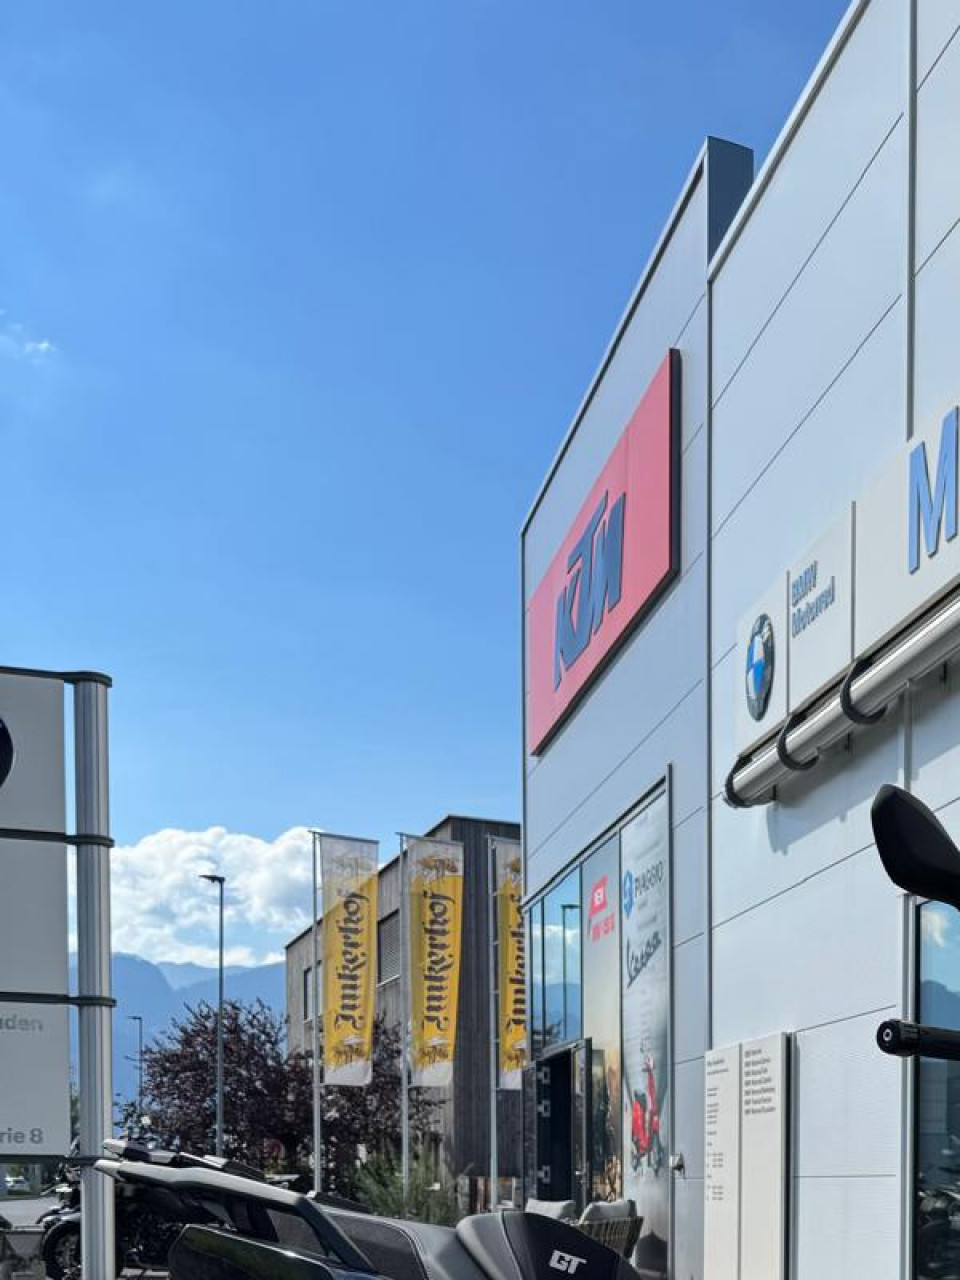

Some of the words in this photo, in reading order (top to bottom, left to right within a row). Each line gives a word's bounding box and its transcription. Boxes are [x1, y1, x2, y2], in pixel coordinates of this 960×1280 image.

[553, 489, 626, 692] KTM
[29, 1127, 44, 1144] 8
[549, 1249, 588, 1275] GT
